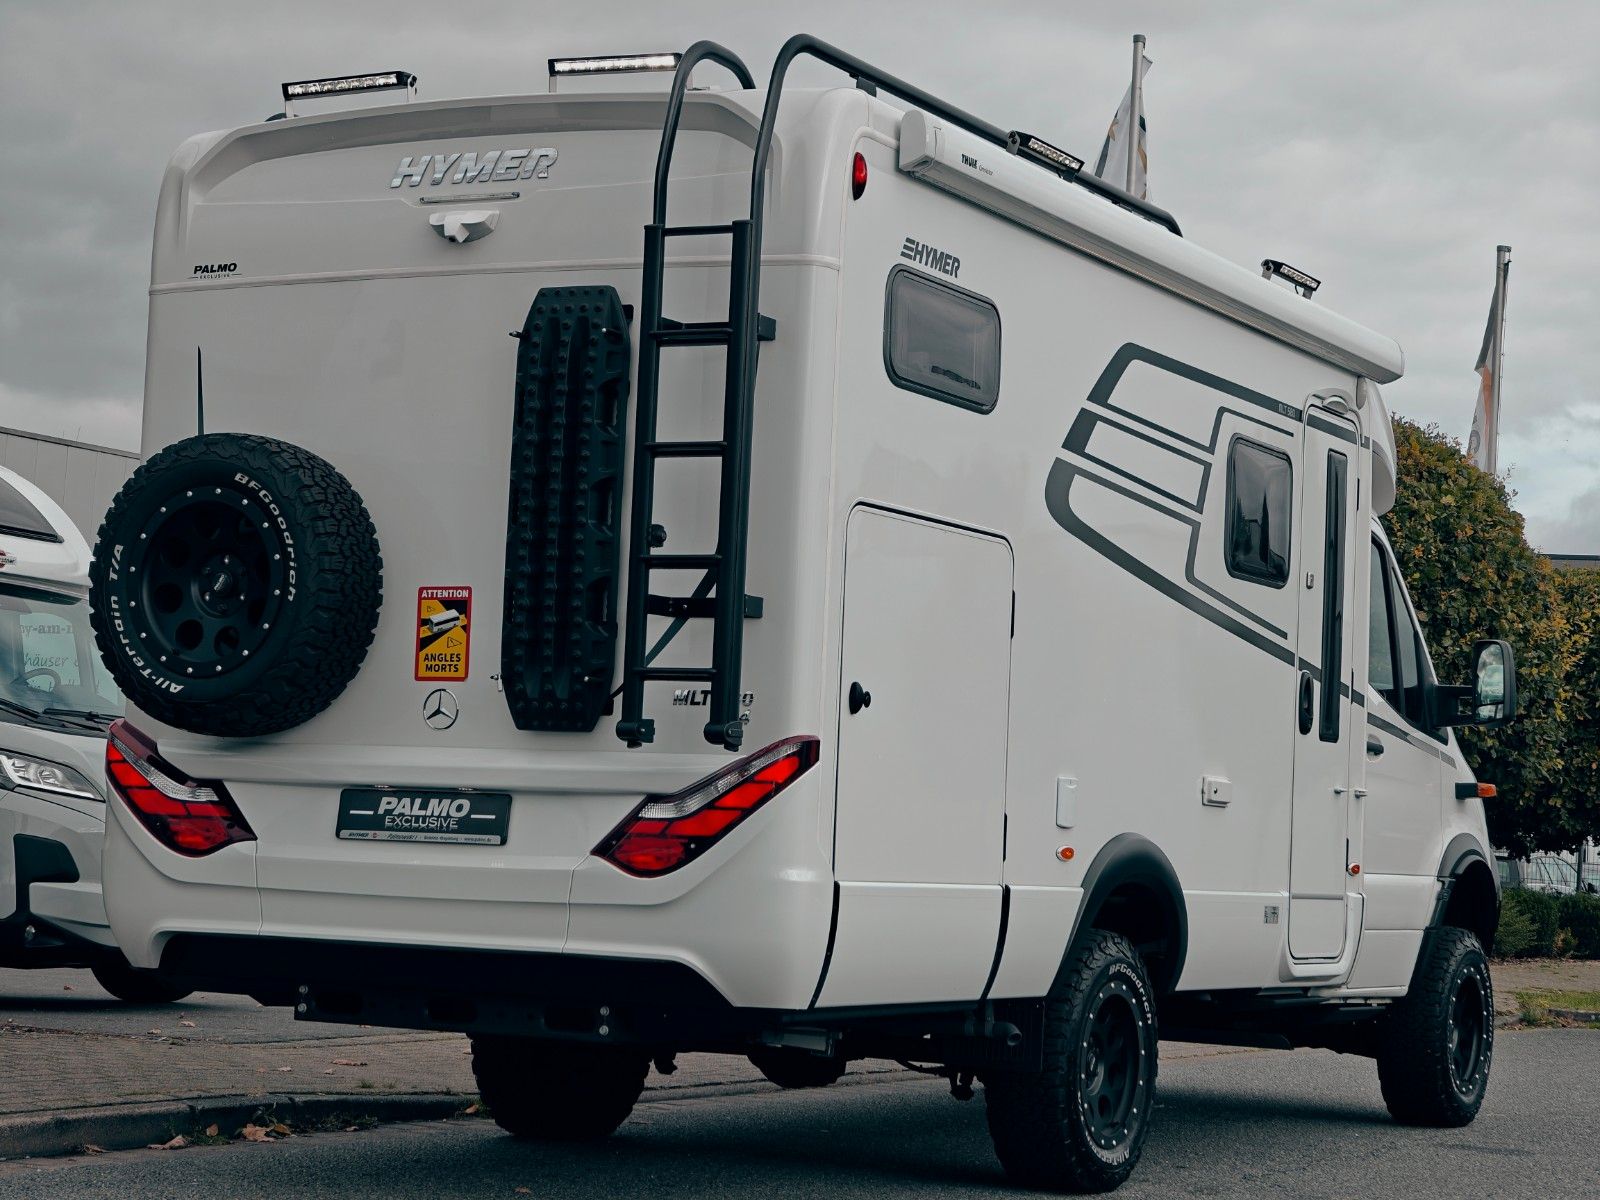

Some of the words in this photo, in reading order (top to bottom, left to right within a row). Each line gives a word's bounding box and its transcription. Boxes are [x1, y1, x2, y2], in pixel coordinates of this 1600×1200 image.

[390, 147, 558, 188] HYMER
[961, 153, 978, 169] THULE
[193, 262, 237, 274] PALMO
[913, 241, 960, 278] HYMER
[234, 472, 297, 602] BFGoodrich
[109, 544, 124, 582] T/A
[421, 589, 469, 598] ATTENTION
[111, 595, 185, 694] All-Terrain
[423, 653, 462, 662] ANGLES
[425, 663, 459, 673] MORTS
[377, 796, 471, 818] PALMO
[384, 815, 459, 828] EXCLUSIVE
